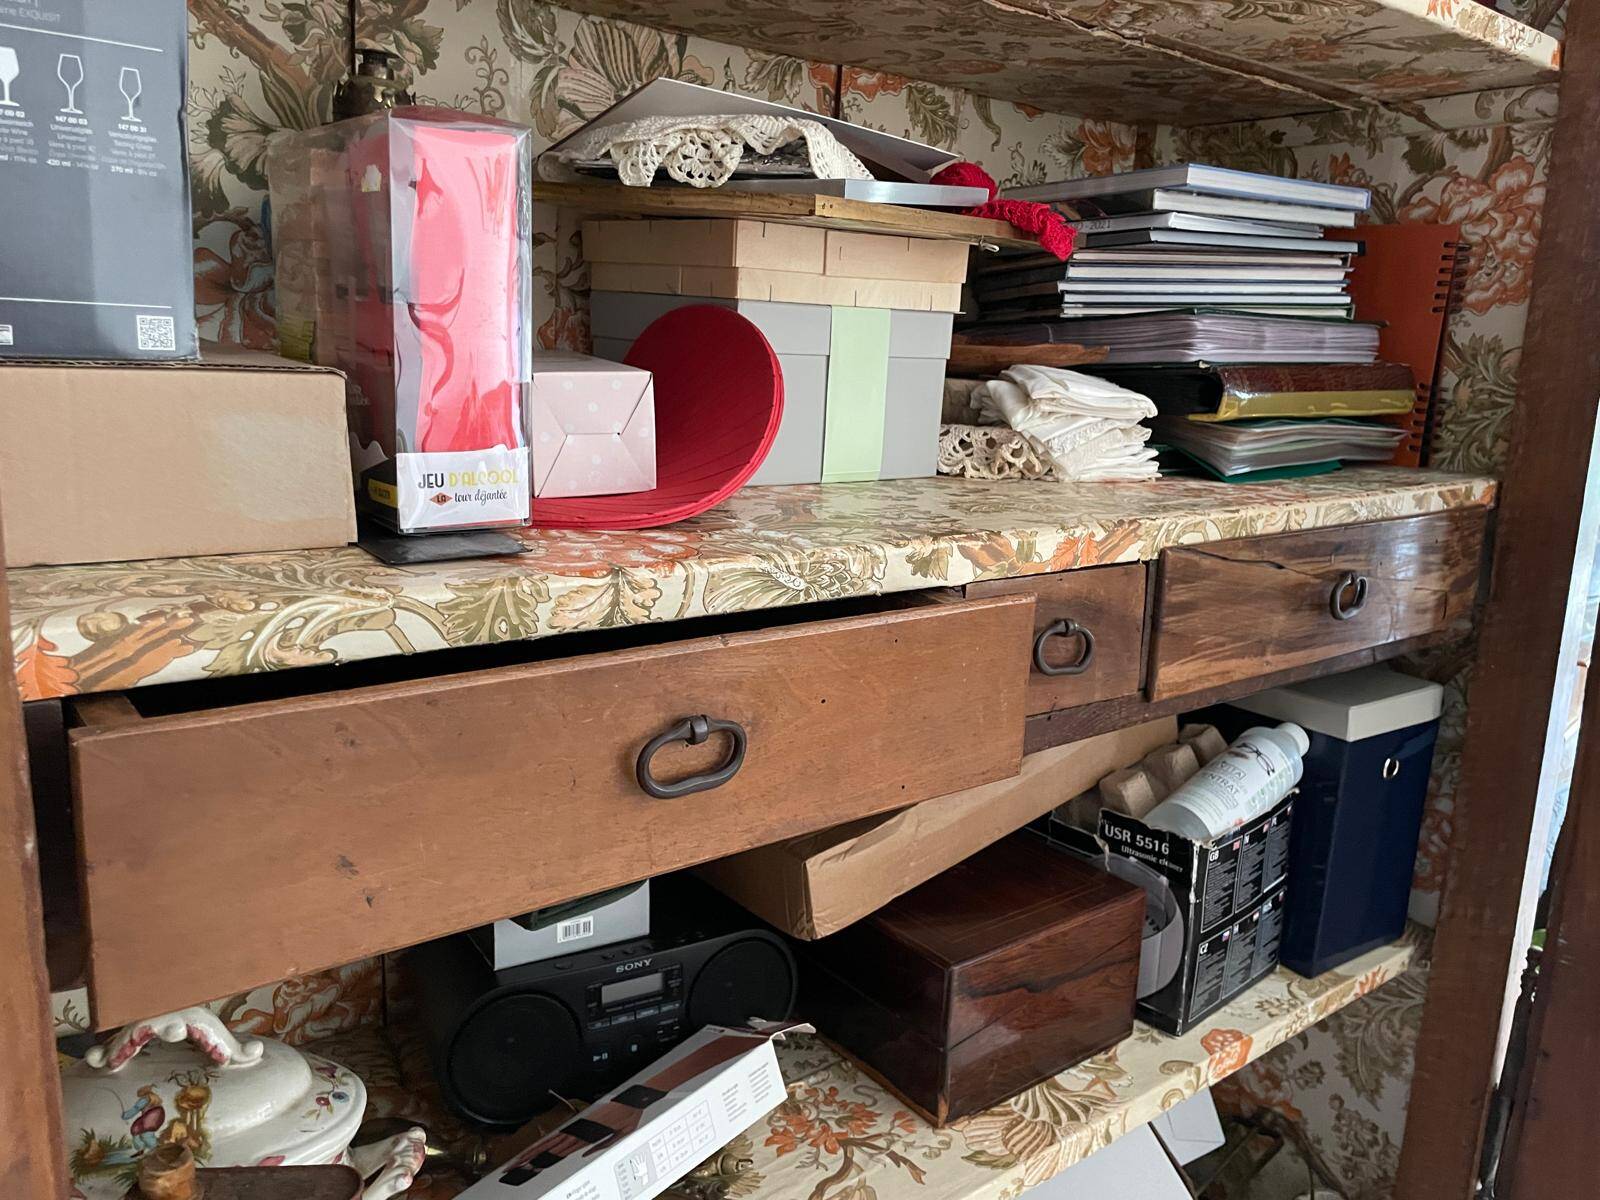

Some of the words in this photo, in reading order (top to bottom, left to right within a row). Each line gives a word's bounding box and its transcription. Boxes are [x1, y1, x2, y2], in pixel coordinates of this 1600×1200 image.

[418, 473, 445, 488] JEU
[449, 467, 519, 487] D'ALCOOL
[1105, 823, 1131, 843] USR
[1135, 834, 1170, 855] 5516
[1121, 845, 1158, 863] Ultrasonic
[1209, 850, 1219, 862] GB
[616, 957, 652, 973] SONY
